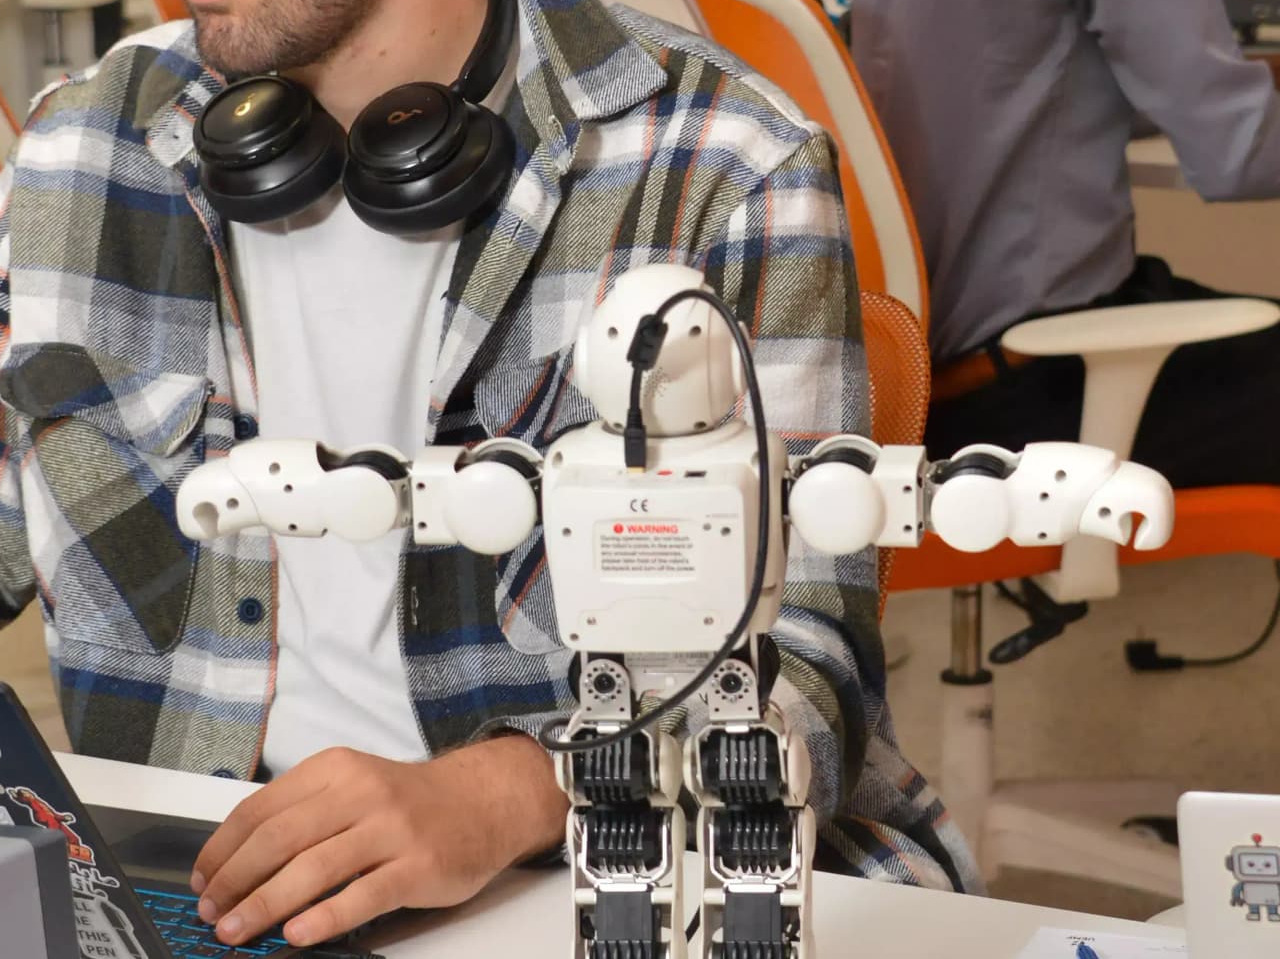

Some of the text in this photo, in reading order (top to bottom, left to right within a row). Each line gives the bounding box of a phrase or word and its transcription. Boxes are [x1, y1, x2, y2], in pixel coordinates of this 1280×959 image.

[630, 498, 649, 512] CE
[626, 524, 679, 534] WARNING
[78, 930, 111, 942] THIS
[86, 944, 116, 957] PEN
